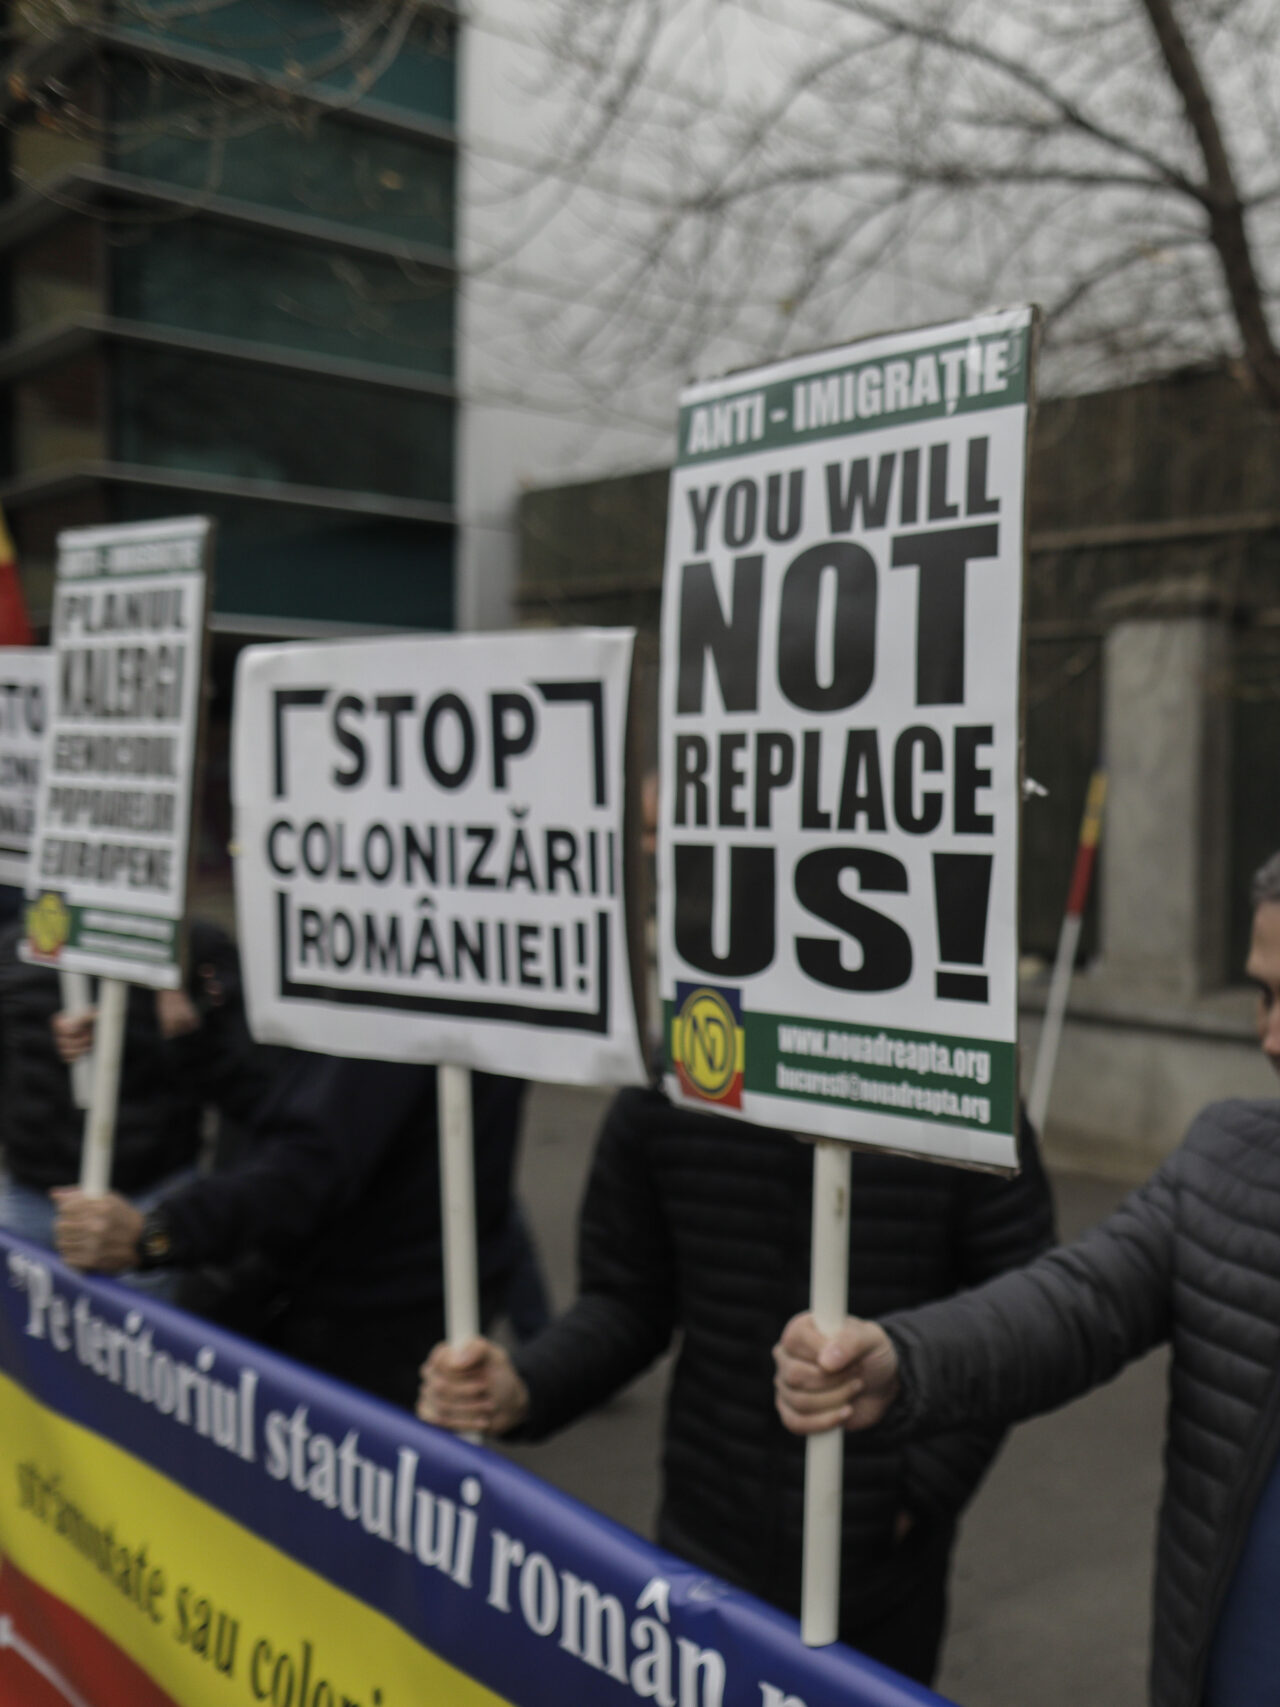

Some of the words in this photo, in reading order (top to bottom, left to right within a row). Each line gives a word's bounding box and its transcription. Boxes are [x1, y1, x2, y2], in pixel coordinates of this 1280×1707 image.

[688, 392, 765, 455] ANTI
[793, 338, 1009, 432] IMIGRAȚIE
[688, 468, 804, 554] YOU
[825, 435, 1001, 534] WILL
[676, 522, 999, 716] NOT
[331, 691, 539, 793] STOP
[673, 725, 994, 836] REPLACE
[267, 805, 617, 898] COLONIZĂRII
[299, 899, 588, 992] ROMÂNIEI!
[673, 844, 994, 1004] US!
[778, 1024, 990, 1084] www.nouadreapta.org
[73, 1295, 258, 1462] teritoriul
[264, 1402, 482, 1589] statului
[488, 1527, 726, 1707] român
[174, 1585, 239, 1680] sau
